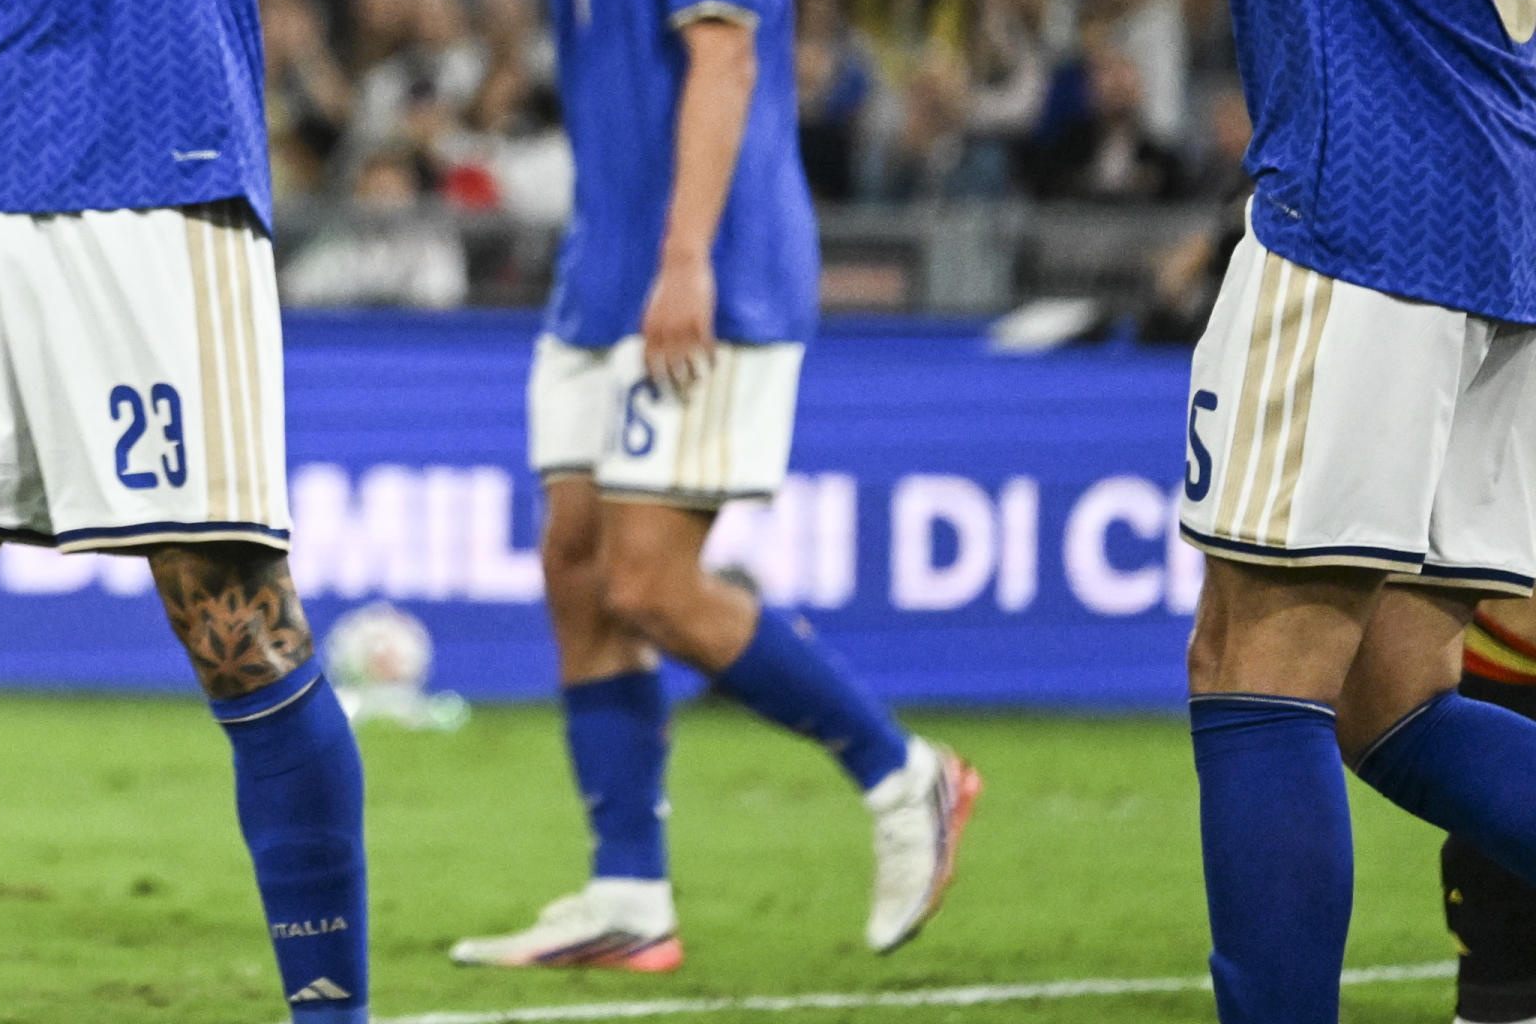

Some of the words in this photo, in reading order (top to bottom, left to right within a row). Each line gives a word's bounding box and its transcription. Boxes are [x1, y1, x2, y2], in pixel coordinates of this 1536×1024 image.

[109, 382, 189, 489] 23
[622, 376, 660, 458] 6
[1184, 388, 1218, 502] 5
